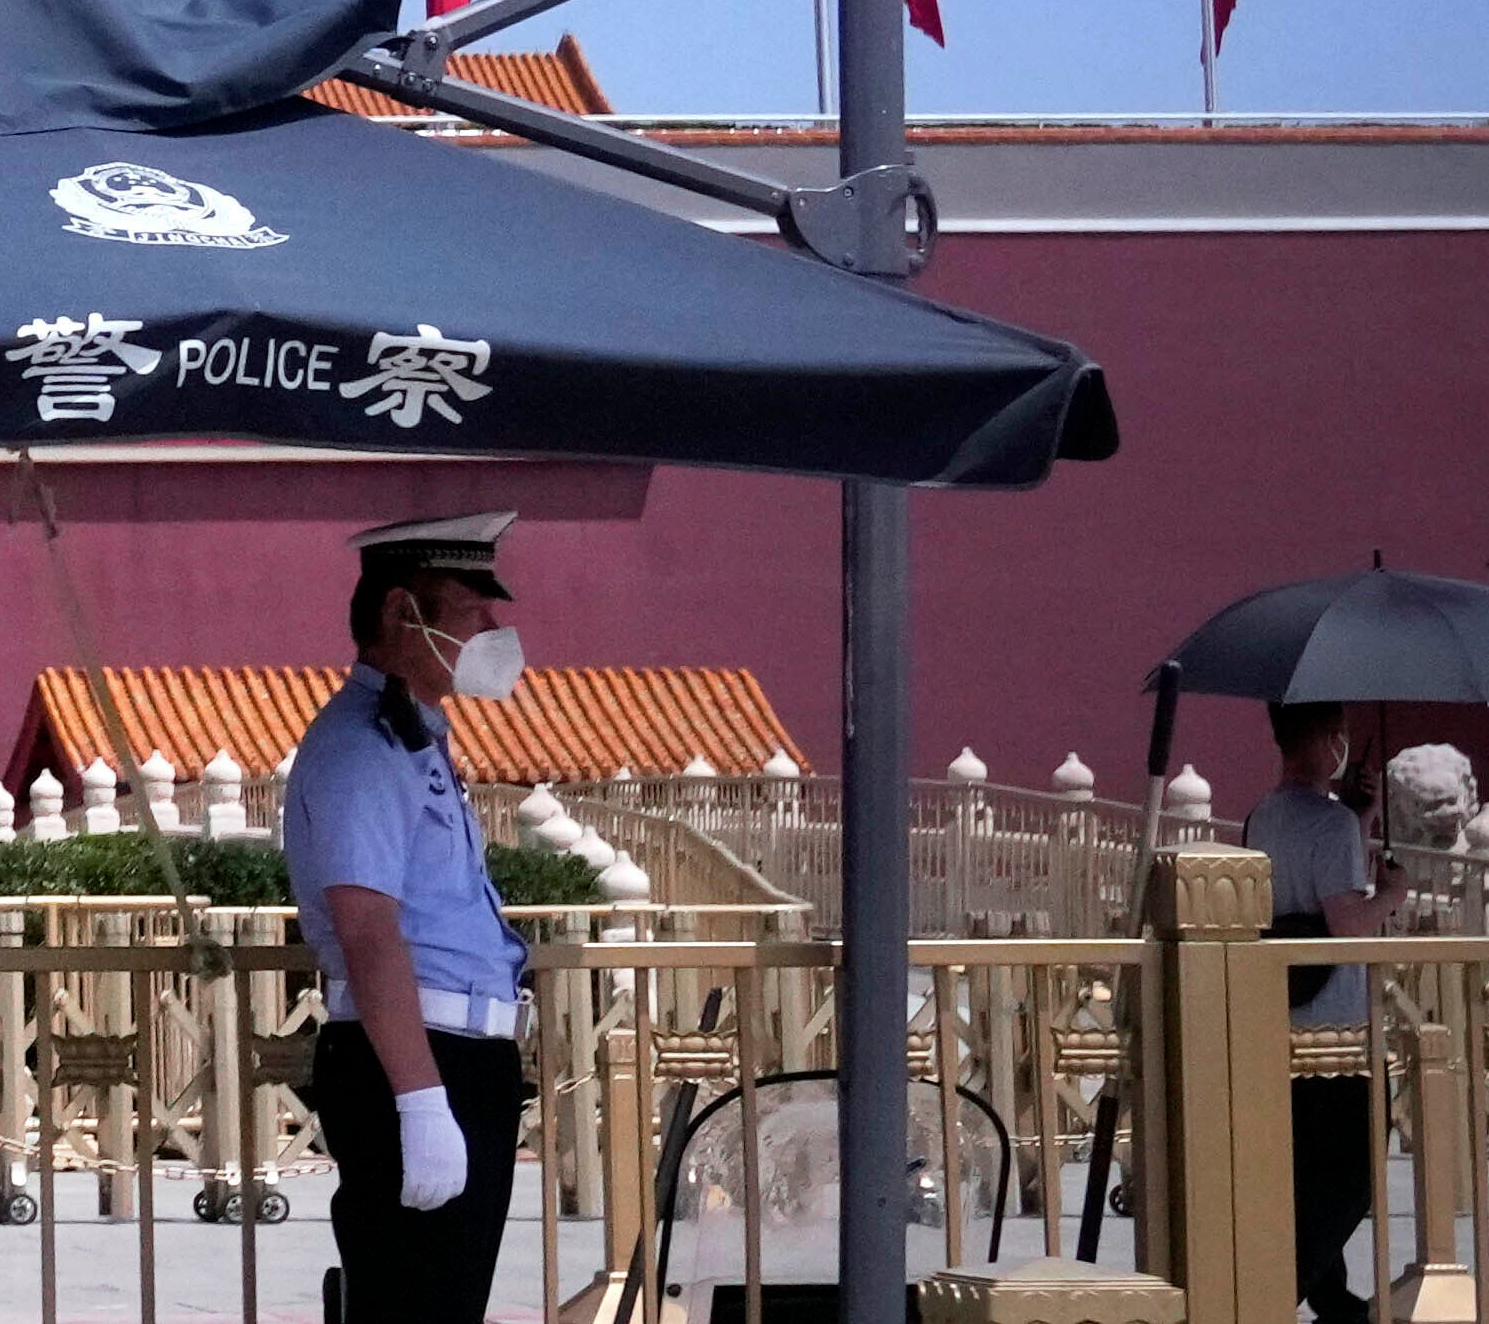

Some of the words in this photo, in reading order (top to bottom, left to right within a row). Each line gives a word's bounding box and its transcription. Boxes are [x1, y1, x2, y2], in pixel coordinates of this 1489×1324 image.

[6, 313, 162, 422] 警
[178, 338, 338, 390] POLICE
[339, 324, 493, 427] 察
